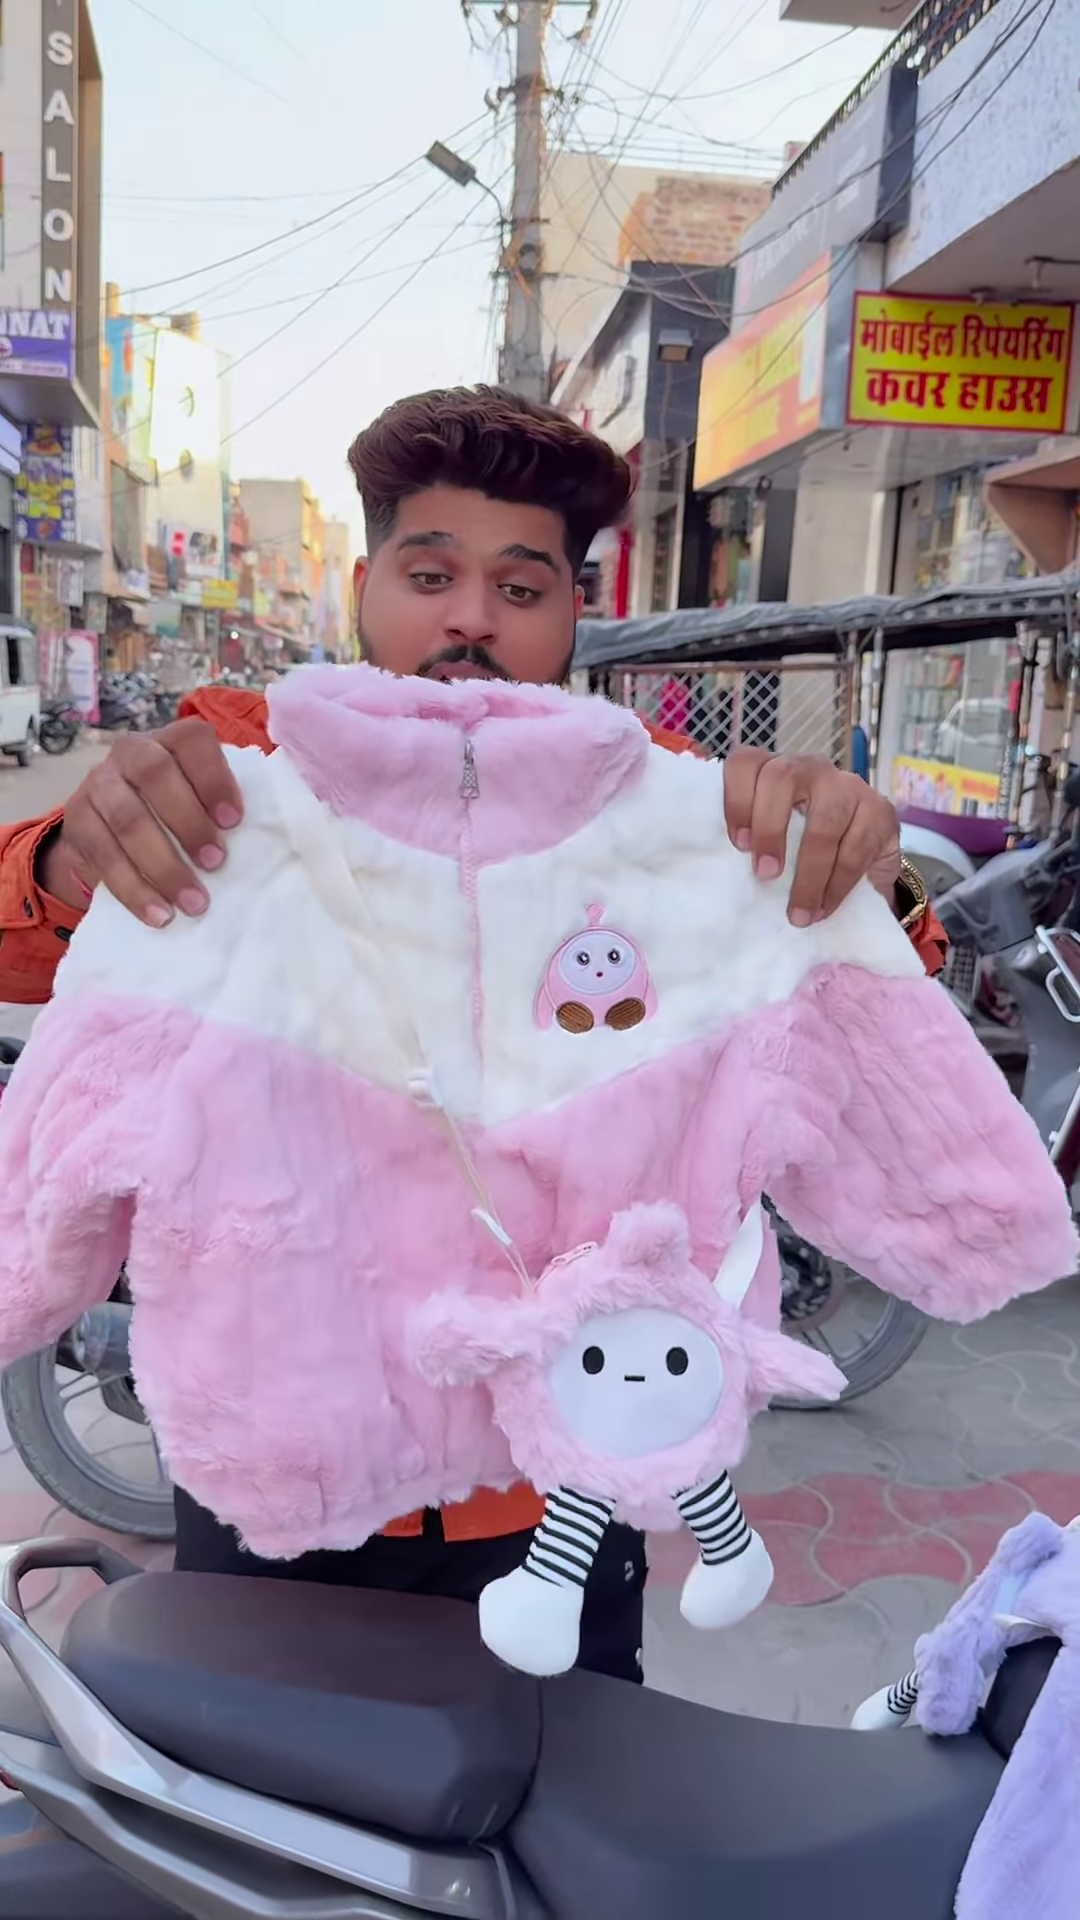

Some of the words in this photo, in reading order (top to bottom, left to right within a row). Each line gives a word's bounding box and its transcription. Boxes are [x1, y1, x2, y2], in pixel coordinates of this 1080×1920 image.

[44, 31, 75, 302] SALON
[861, 308, 958, 361] मोबाईल
[866, 368, 951, 408] कवर
[958, 373, 1054, 414] हाउस
